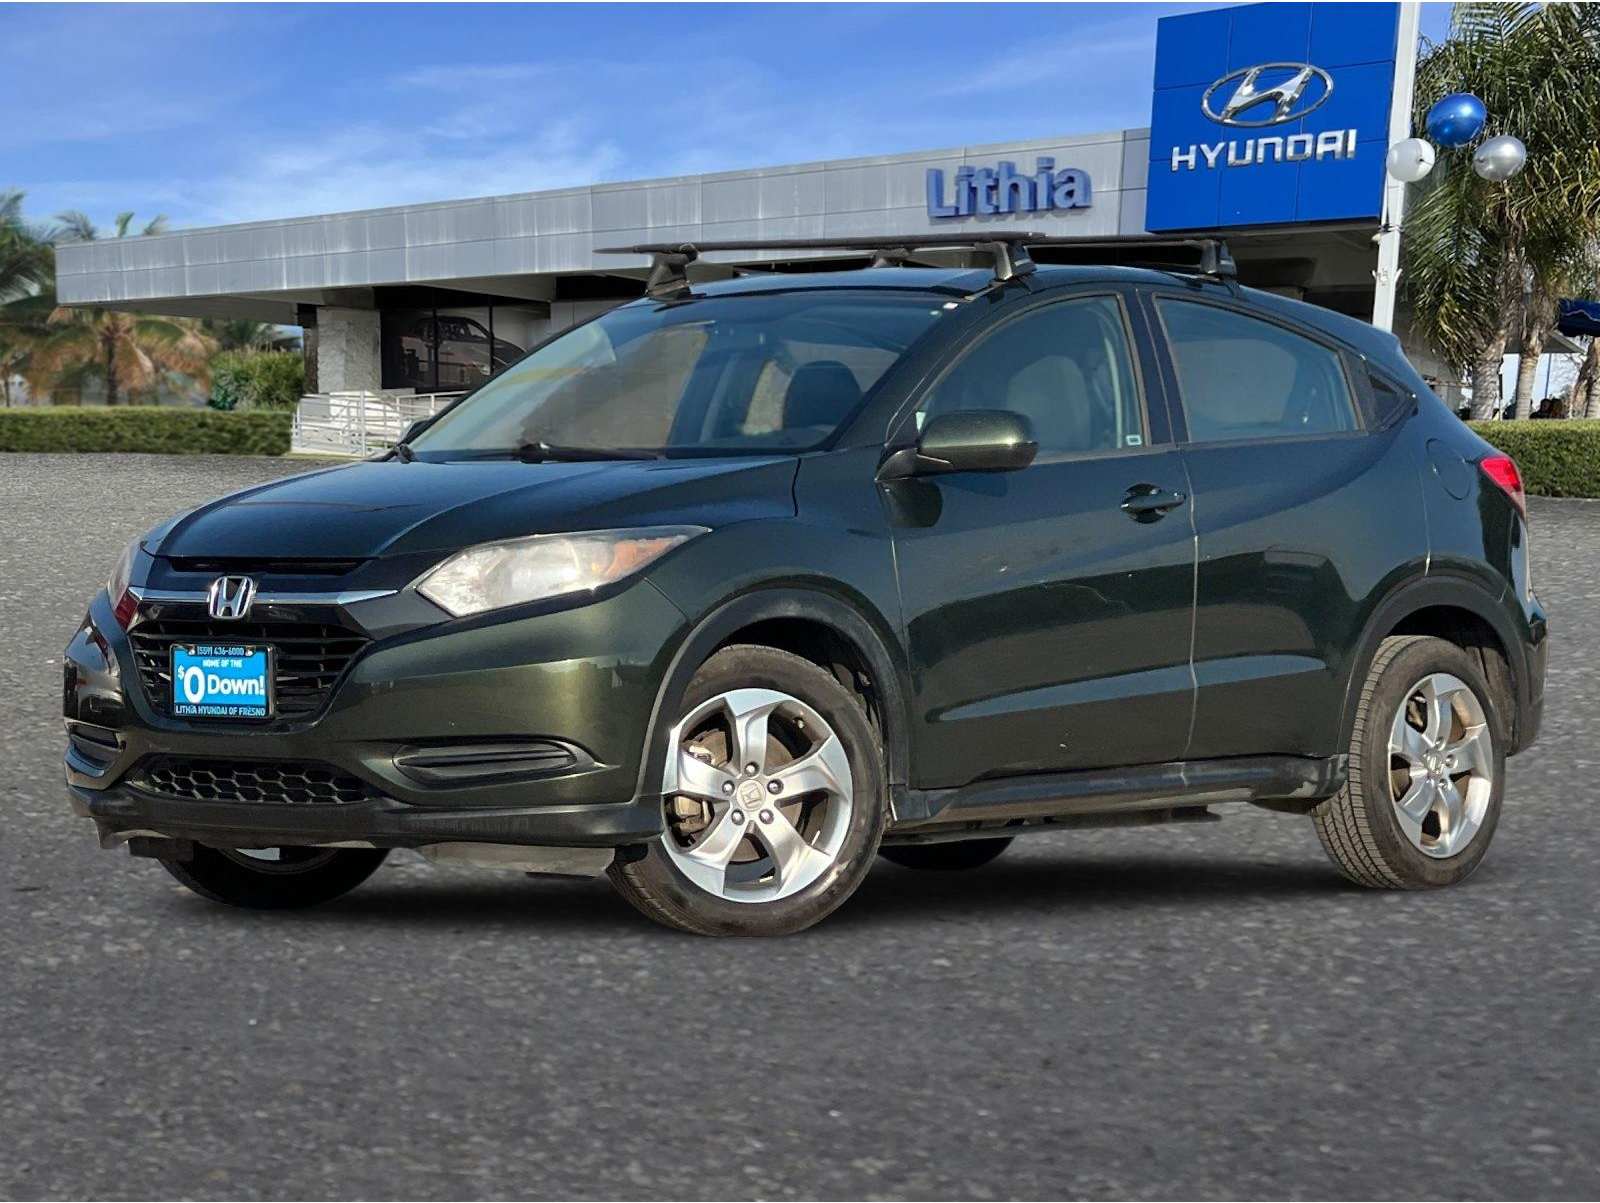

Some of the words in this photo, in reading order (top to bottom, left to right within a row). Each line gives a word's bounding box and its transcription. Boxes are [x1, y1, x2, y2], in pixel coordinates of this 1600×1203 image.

[1171, 128, 1358, 172] HYUNDAI
[926, 155, 1093, 218] Lithia
[202, 659, 220, 668] HOME
[221, 659, 229, 668] OF
[230, 659, 243, 668] THE
[207, 674, 265, 696] Down!
[175, 705, 197, 714] LITHIA
[198, 705, 227, 715] HYUNDAI
[228, 706, 238, 715] OF
[239, 707, 266, 716] FRESNO
